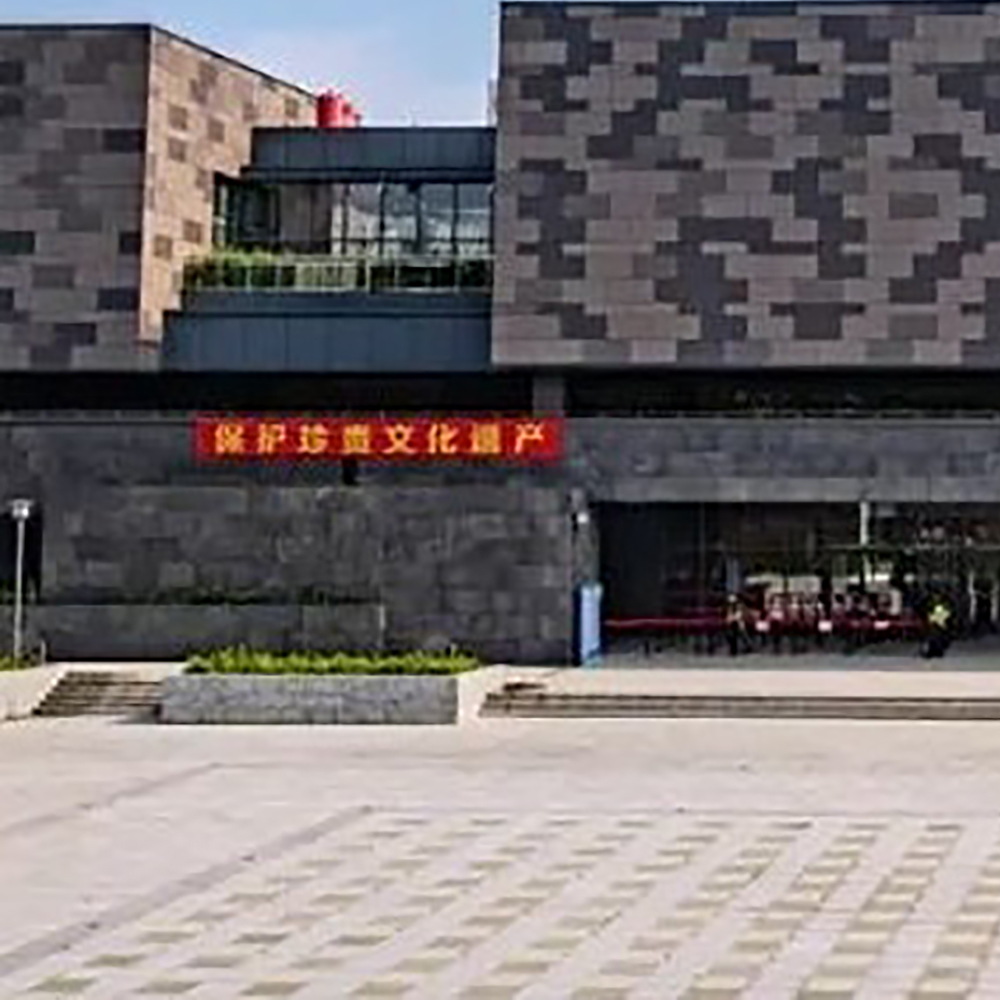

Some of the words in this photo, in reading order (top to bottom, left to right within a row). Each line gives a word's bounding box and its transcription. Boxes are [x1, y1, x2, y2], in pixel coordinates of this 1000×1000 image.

[213, 422, 545, 455] 保护珍贵文化遗产
